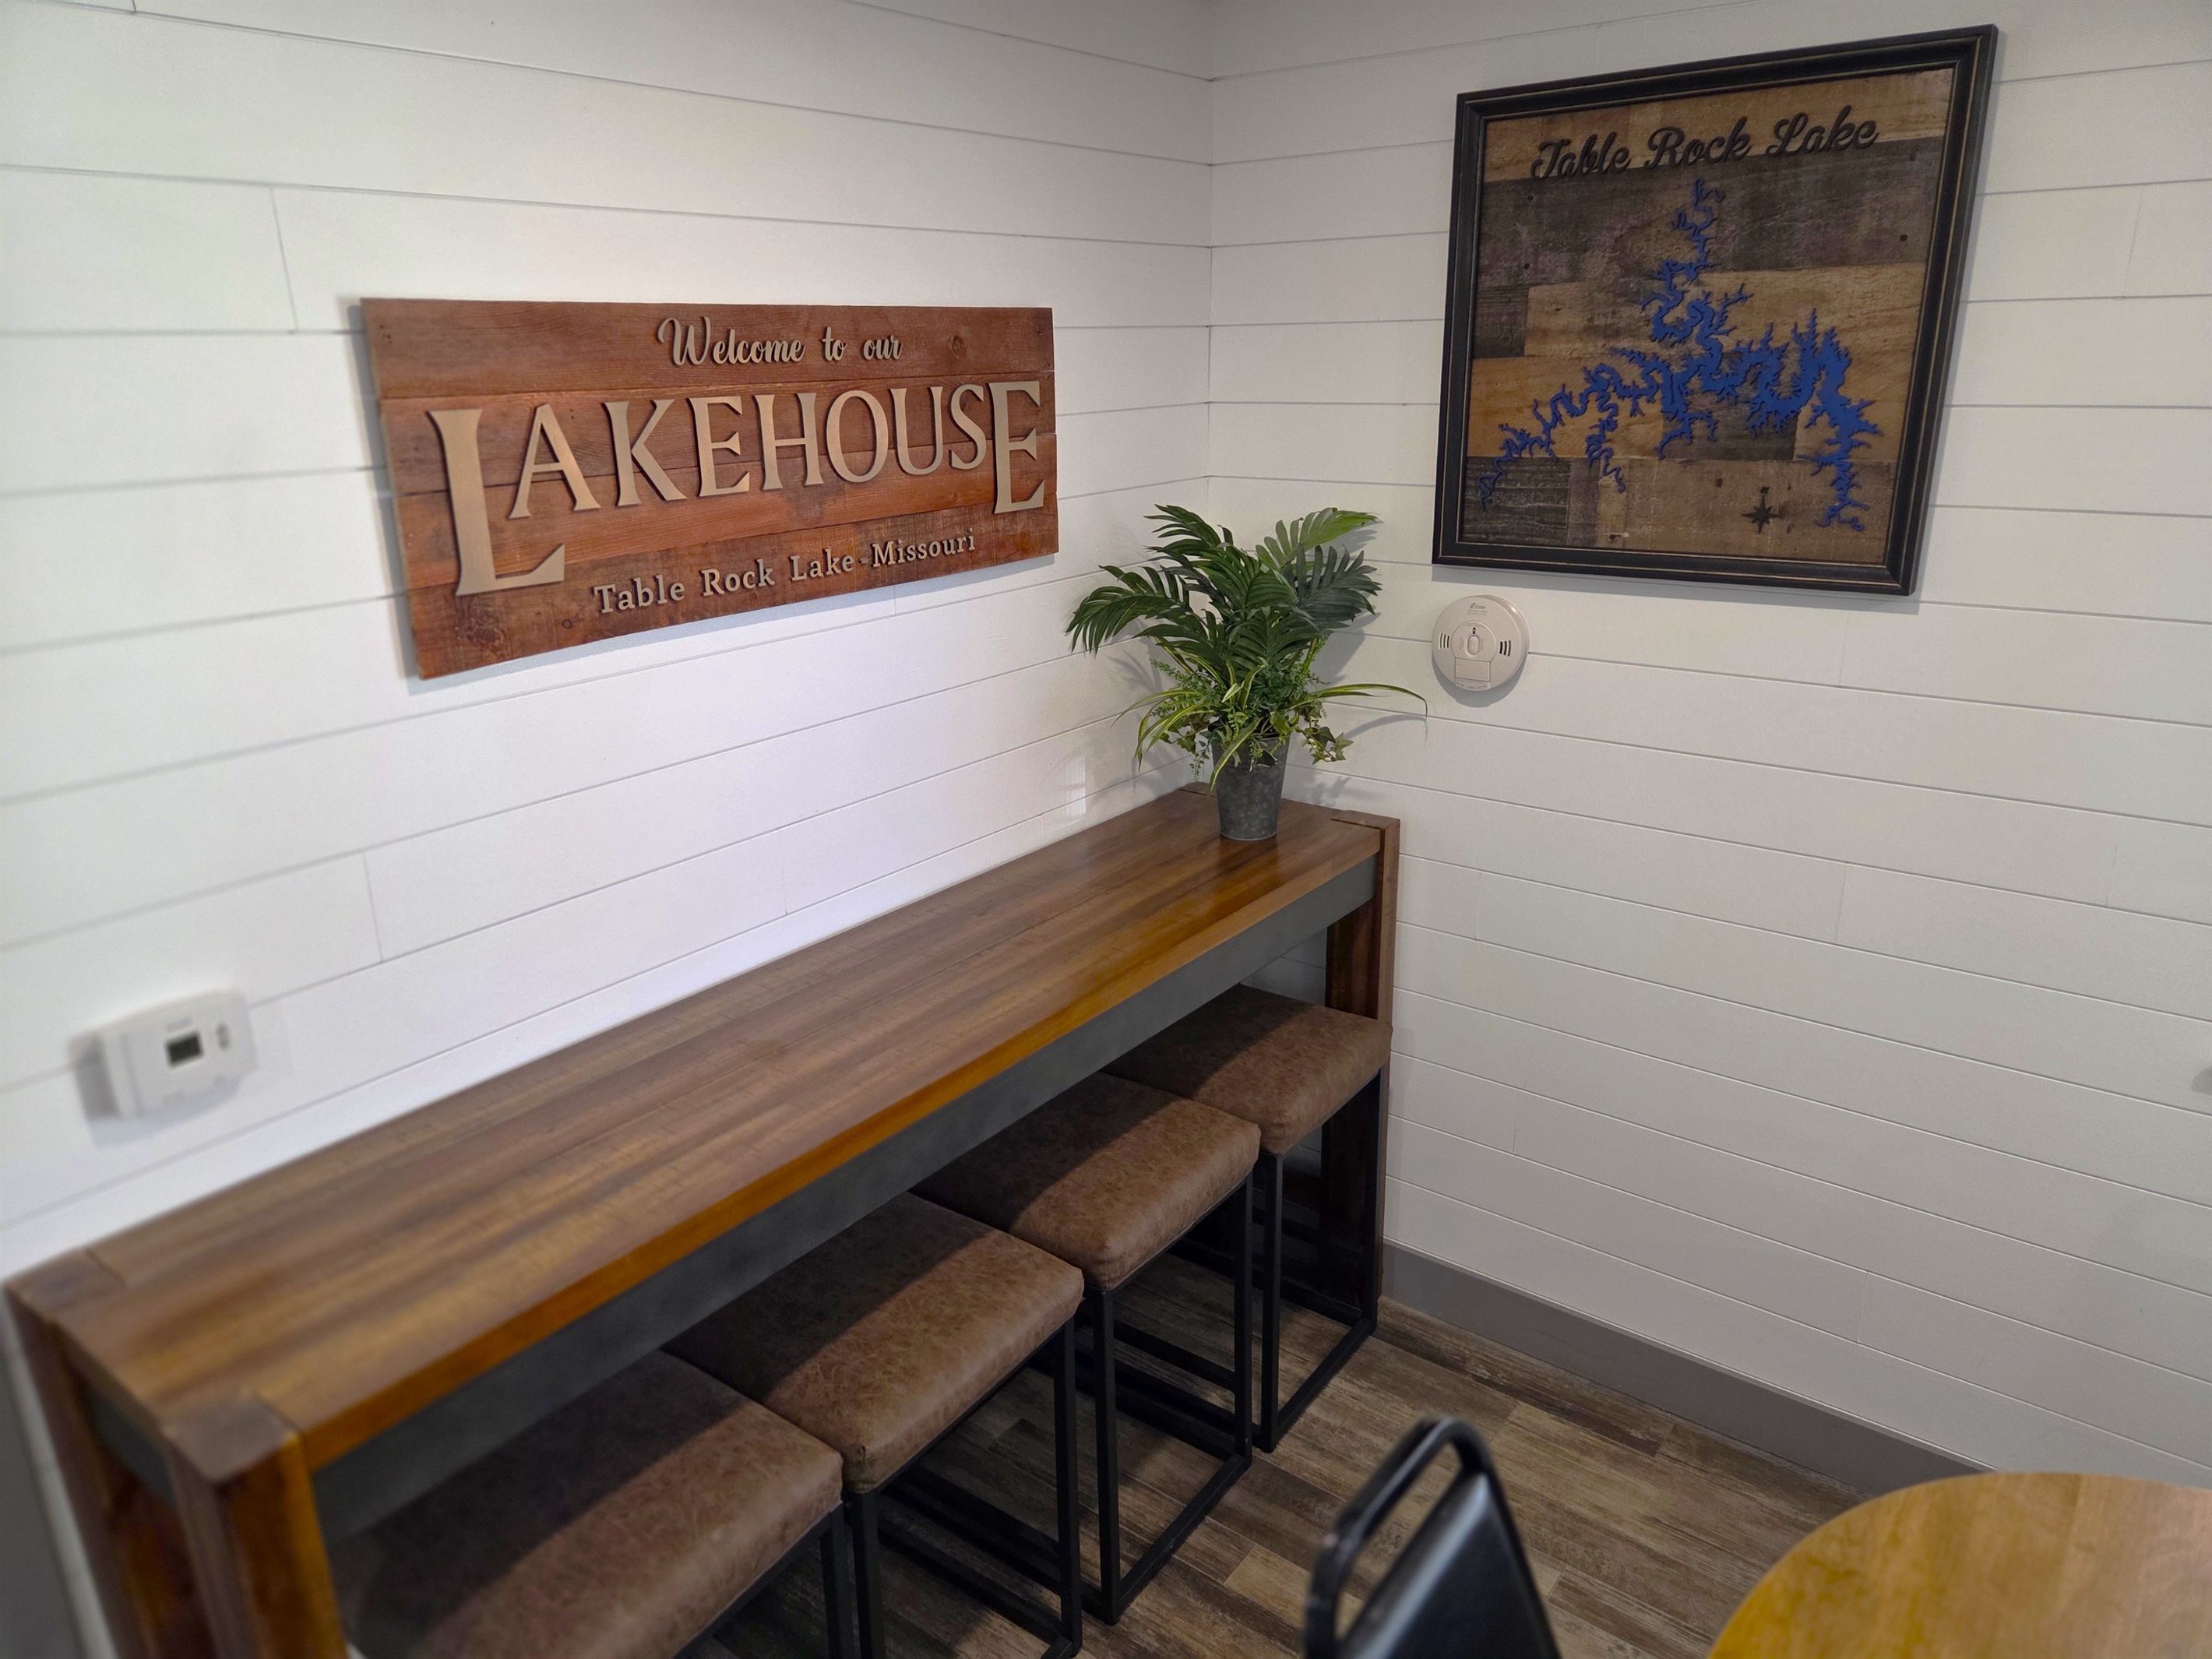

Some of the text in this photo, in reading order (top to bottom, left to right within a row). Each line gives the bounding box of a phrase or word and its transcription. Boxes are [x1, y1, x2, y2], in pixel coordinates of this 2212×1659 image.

[1530, 104, 1879, 180] Table Rock Lake
[657, 315, 904, 366] Welcome to our
[428, 379, 1045, 597] LAKEHOUSE
[593, 573, 685, 614] Table
[700, 558, 776, 597] Rock
